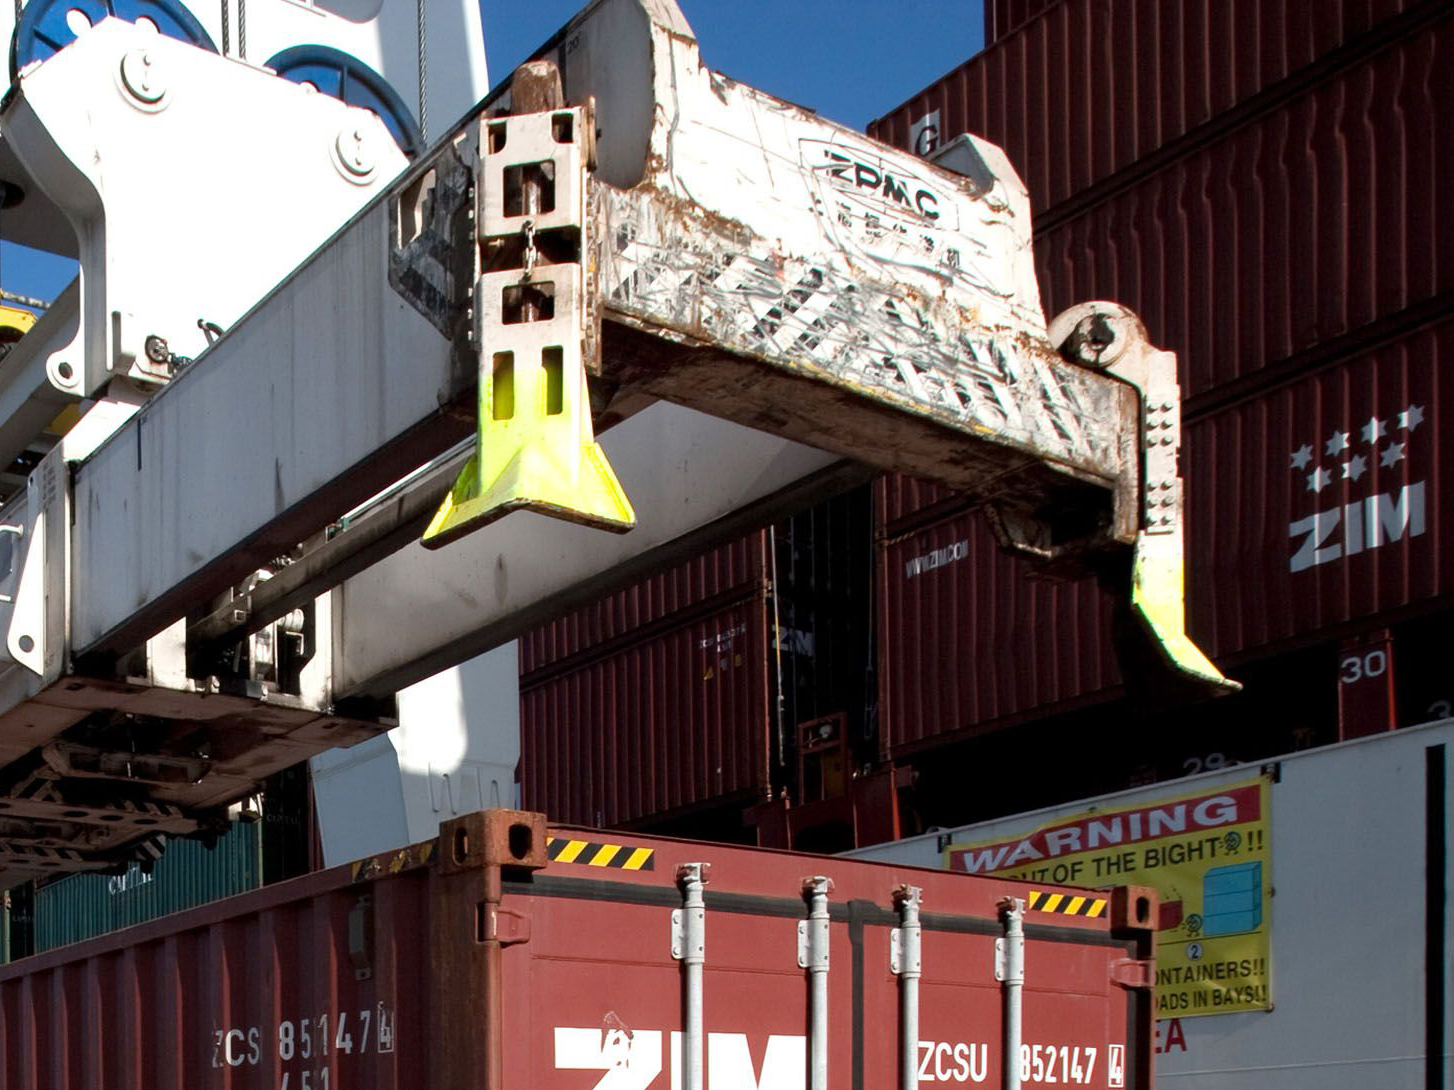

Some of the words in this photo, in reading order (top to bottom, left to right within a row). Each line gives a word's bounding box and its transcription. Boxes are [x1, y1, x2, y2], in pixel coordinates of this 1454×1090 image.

[824, 150, 940, 221] ZPMC
[1289, 480, 1426, 573] ZIM
[1340, 650, 1386, 684] 30
[963, 795, 1238, 874] WARNING
[1052, 861, 1084, 884] OF
[1092, 852, 1136, 878] THE
[1143, 837, 1218, 869] BIGHT
[1156, 957, 1265, 986] NTAINERS!!
[1190, 944, 1200, 960] 2
[1156, 992, 1189, 1010] ADS
[1193, 990, 1209, 1007] IN
[917, 1041, 988, 1083] ZCSU
[1020, 1044, 1097, 1085] 852147
[1109, 1045, 1123, 1086] 4
